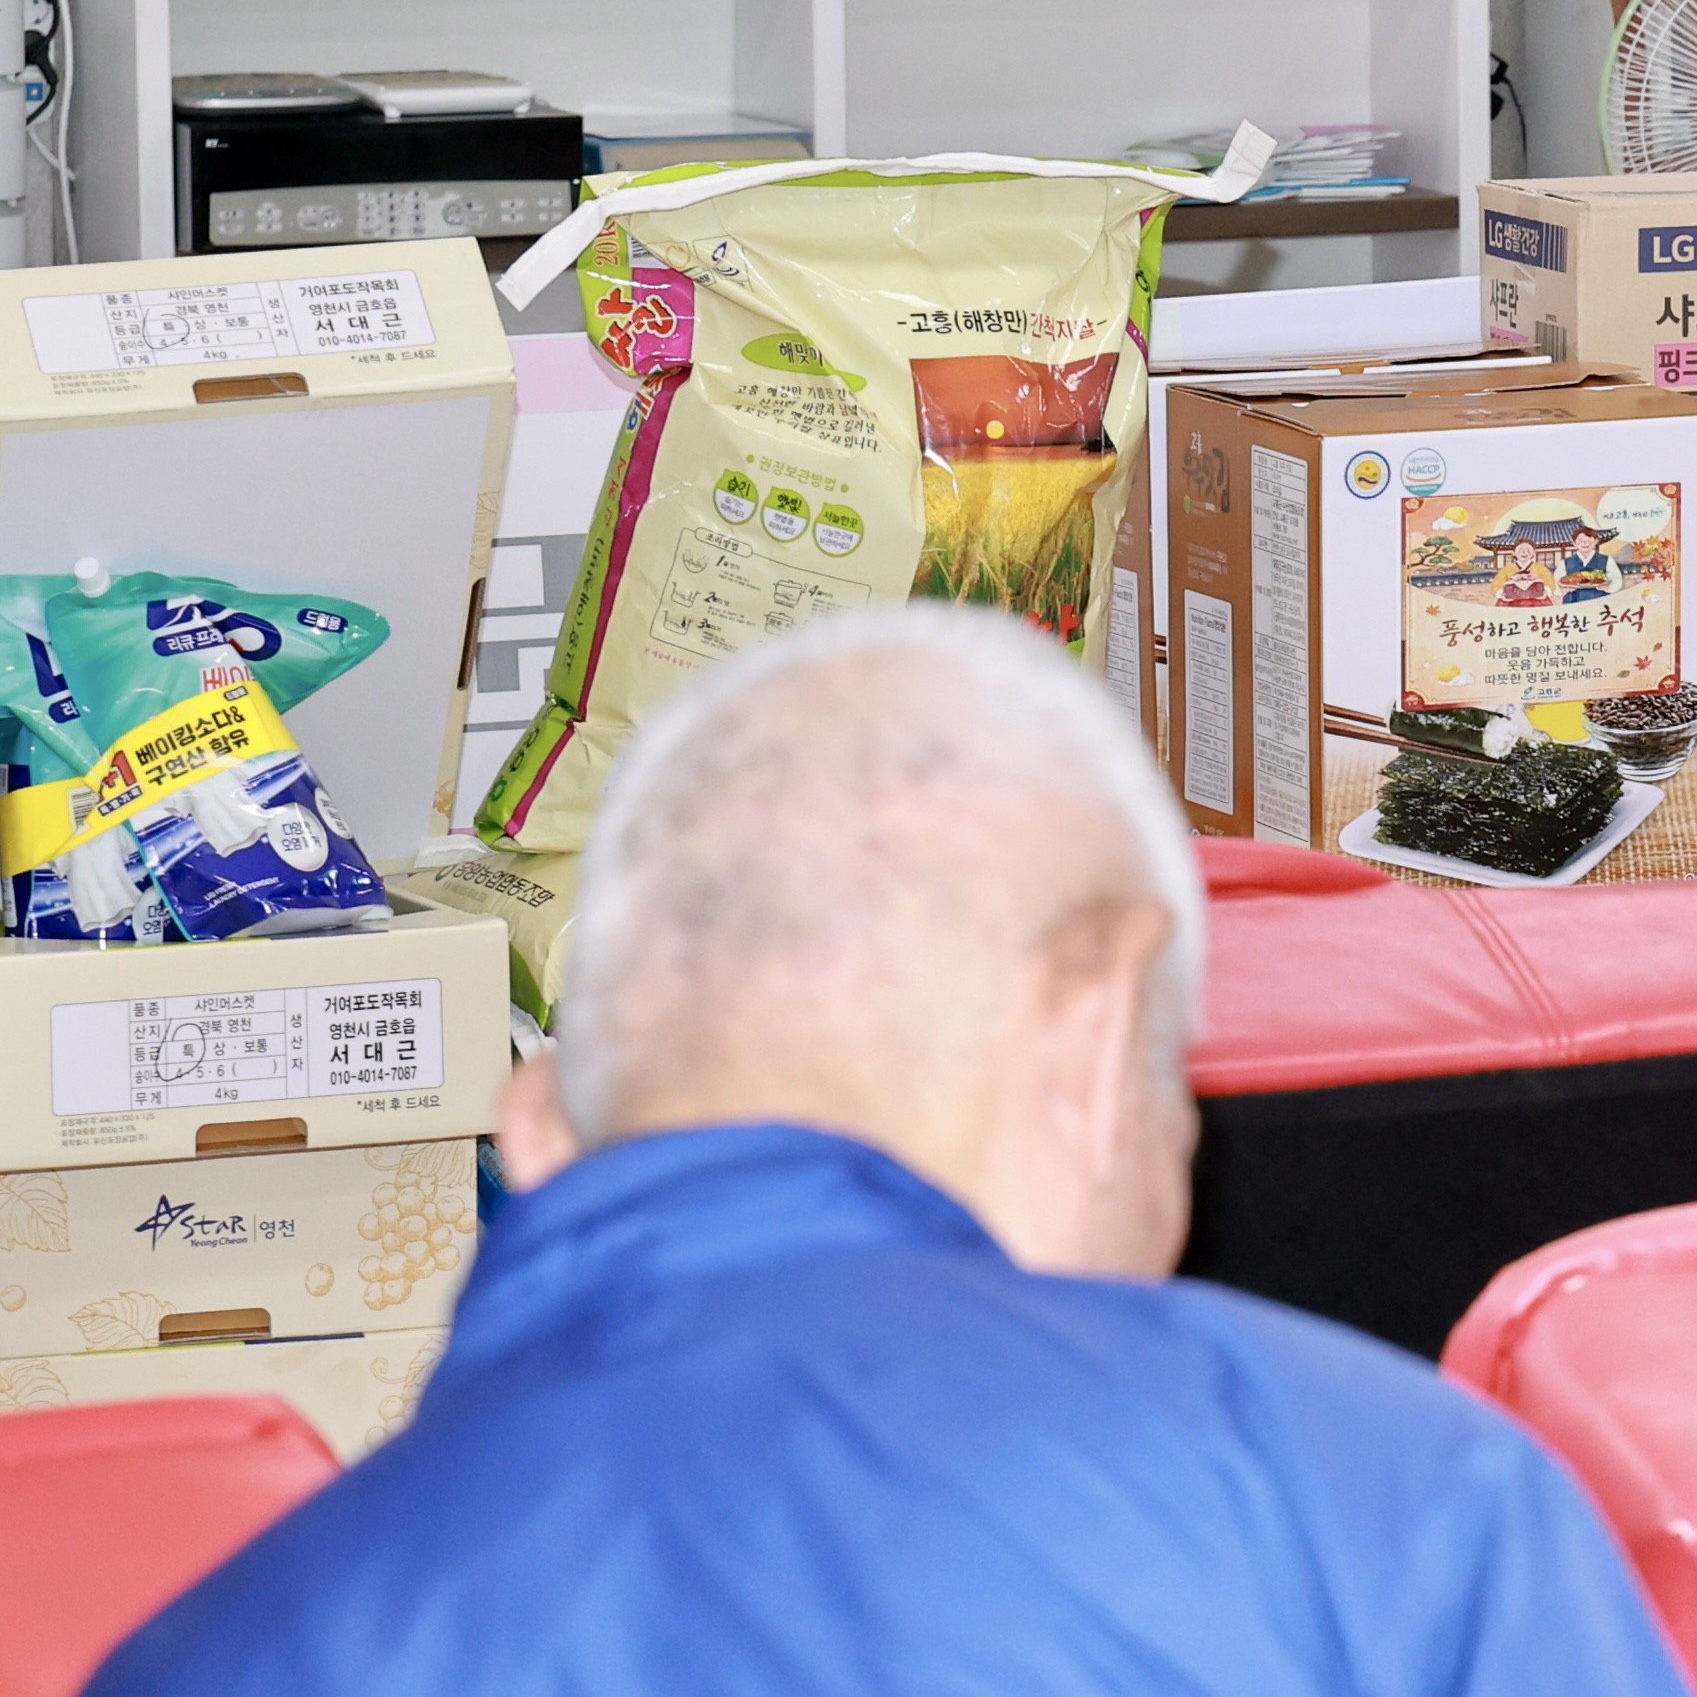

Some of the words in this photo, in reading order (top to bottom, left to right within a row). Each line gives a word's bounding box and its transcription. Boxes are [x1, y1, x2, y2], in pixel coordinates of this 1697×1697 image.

[1488, 219, 1504, 248] LG
[1503, 224, 1540, 258] 생활건강
[1652, 235, 1696, 264] LG
[168, 287, 229, 300] 샤인머스켓
[300, 278, 399, 298] 거여포도작목회
[176, 303, 199, 315] 경북
[206, 302, 229, 313] 영천
[309, 302, 350, 316] 영천시
[355, 298, 397, 312] 금호읍
[1490, 277, 1519, 329] 샤프란
[318, 330, 406, 347] 010-4014-7087
[1408, 464, 1440, 475] HACCP
[1439, 619, 1521, 647] 풍성하고
[1527, 612, 1590, 638] 행복한
[1597, 605, 1645, 637] 추석
[1484, 645, 1521, 659] 마음을
[1525, 644, 1550, 657] 담아
[1554, 642, 1607, 655] 전합니다.
[1507, 658, 1532, 671] 웃음
[1536, 656, 1585, 669] 가득하고
[1484, 673, 1521, 685] 따뜻한
[1526, 671, 1550, 684] 명절
[1554, 668, 1607, 681] 보내세요.
[145, 748, 207, 786] 구연산
[210, 728, 250, 761] 함유
[195, 995, 255, 1012] 샤인머스켓
[324, 990, 422, 1014] 거여포도작목회
[199, 1020, 221, 1035] 경북
[228, 1017, 252, 1033] 영천
[329, 1021, 370, 1040] 영천시
[375, 1018, 416, 1036] 금호읍
[183, 1043, 195, 1058] 특
[213, 1042, 226, 1056] 상
[244, 1037, 268, 1054] 보통
[330, 1066, 417, 1085] 010-4014-7087
[215, 1087, 239, 1100] 4kg
[390, 1098, 401, 1110] 후
[406, 1096, 440, 1109] 드세요
[259, 1219, 296, 1240] 영천
